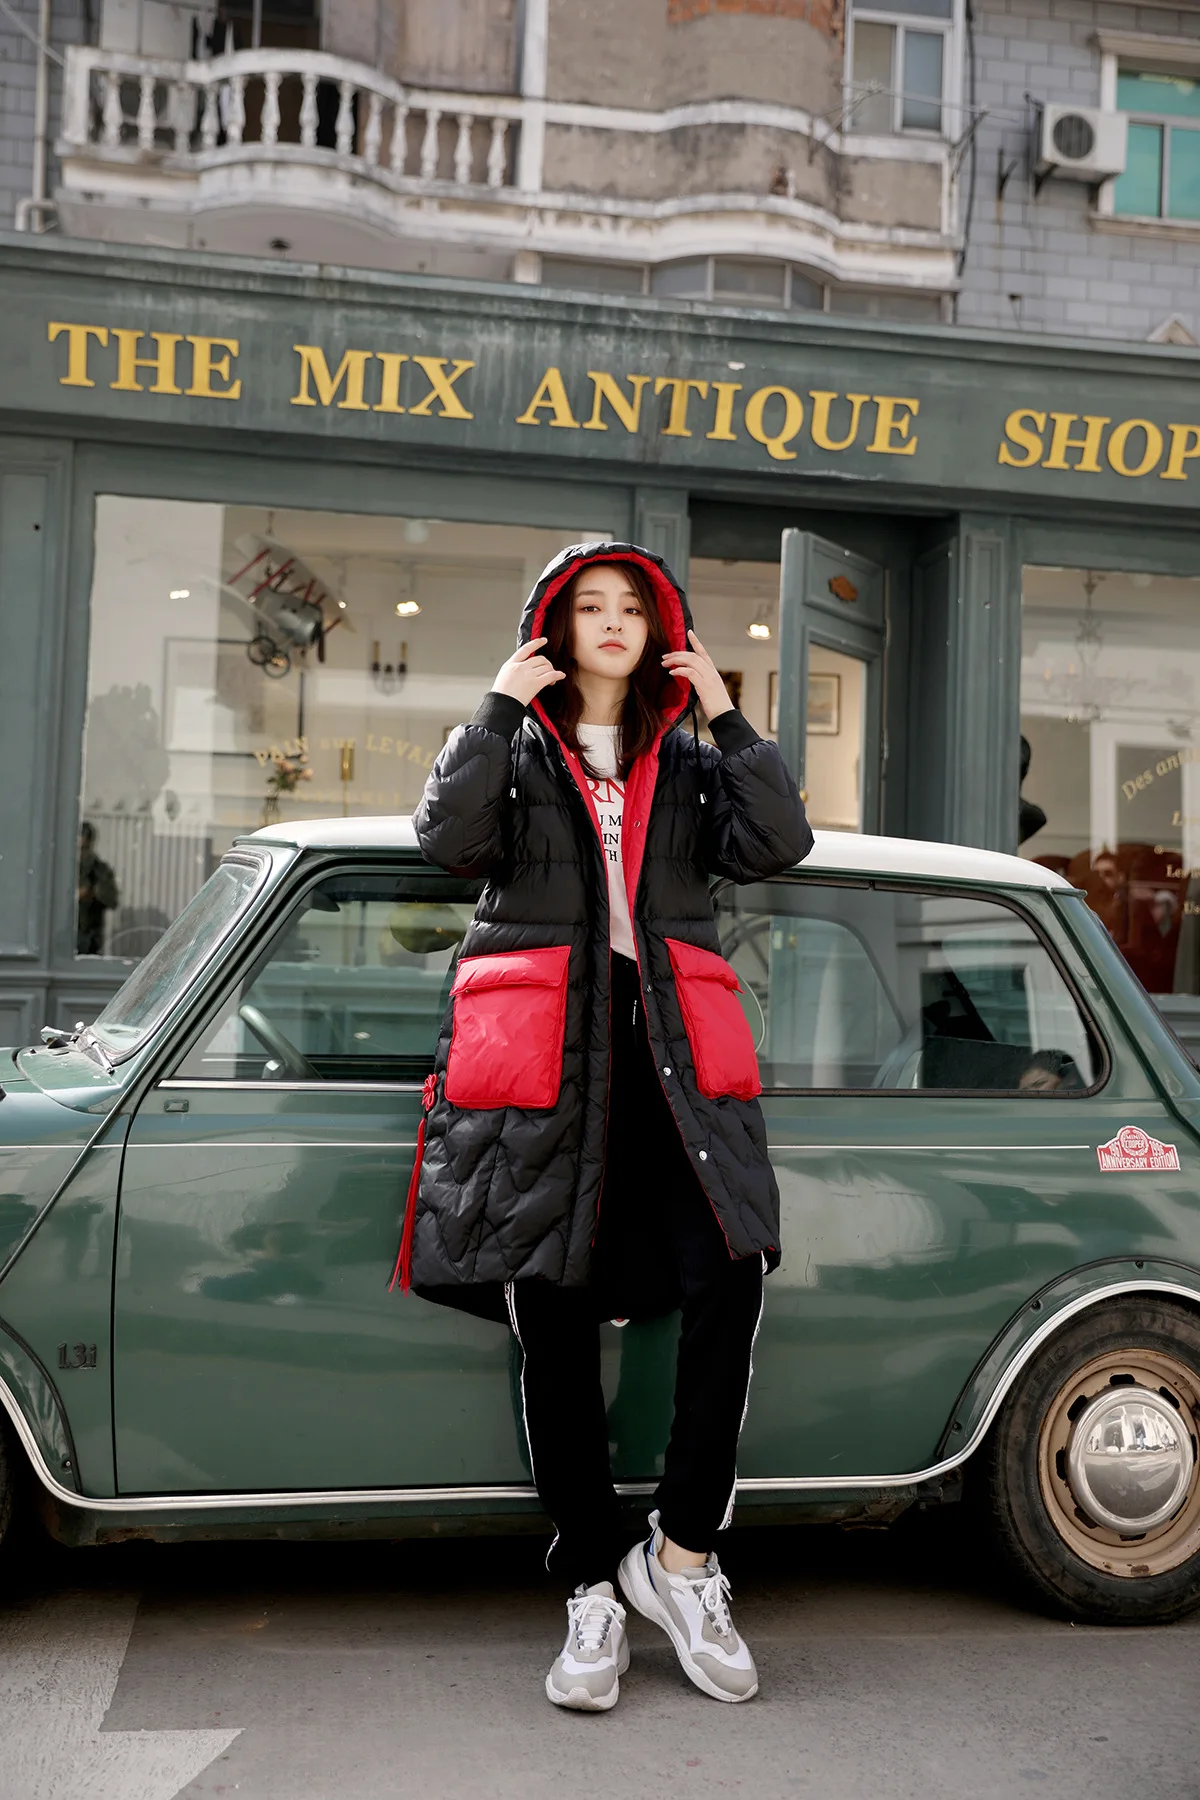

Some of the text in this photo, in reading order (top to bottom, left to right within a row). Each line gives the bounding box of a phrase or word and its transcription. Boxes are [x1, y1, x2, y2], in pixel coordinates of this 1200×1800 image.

[48, 321, 1200, 481] THE MIX ANTIQUE SHOP
[253, 736, 309, 768] PAIN
[1121, 767, 1154, 801] Des
[1101, 1149, 1176, 1168] ANNIVERSARY EDITION
